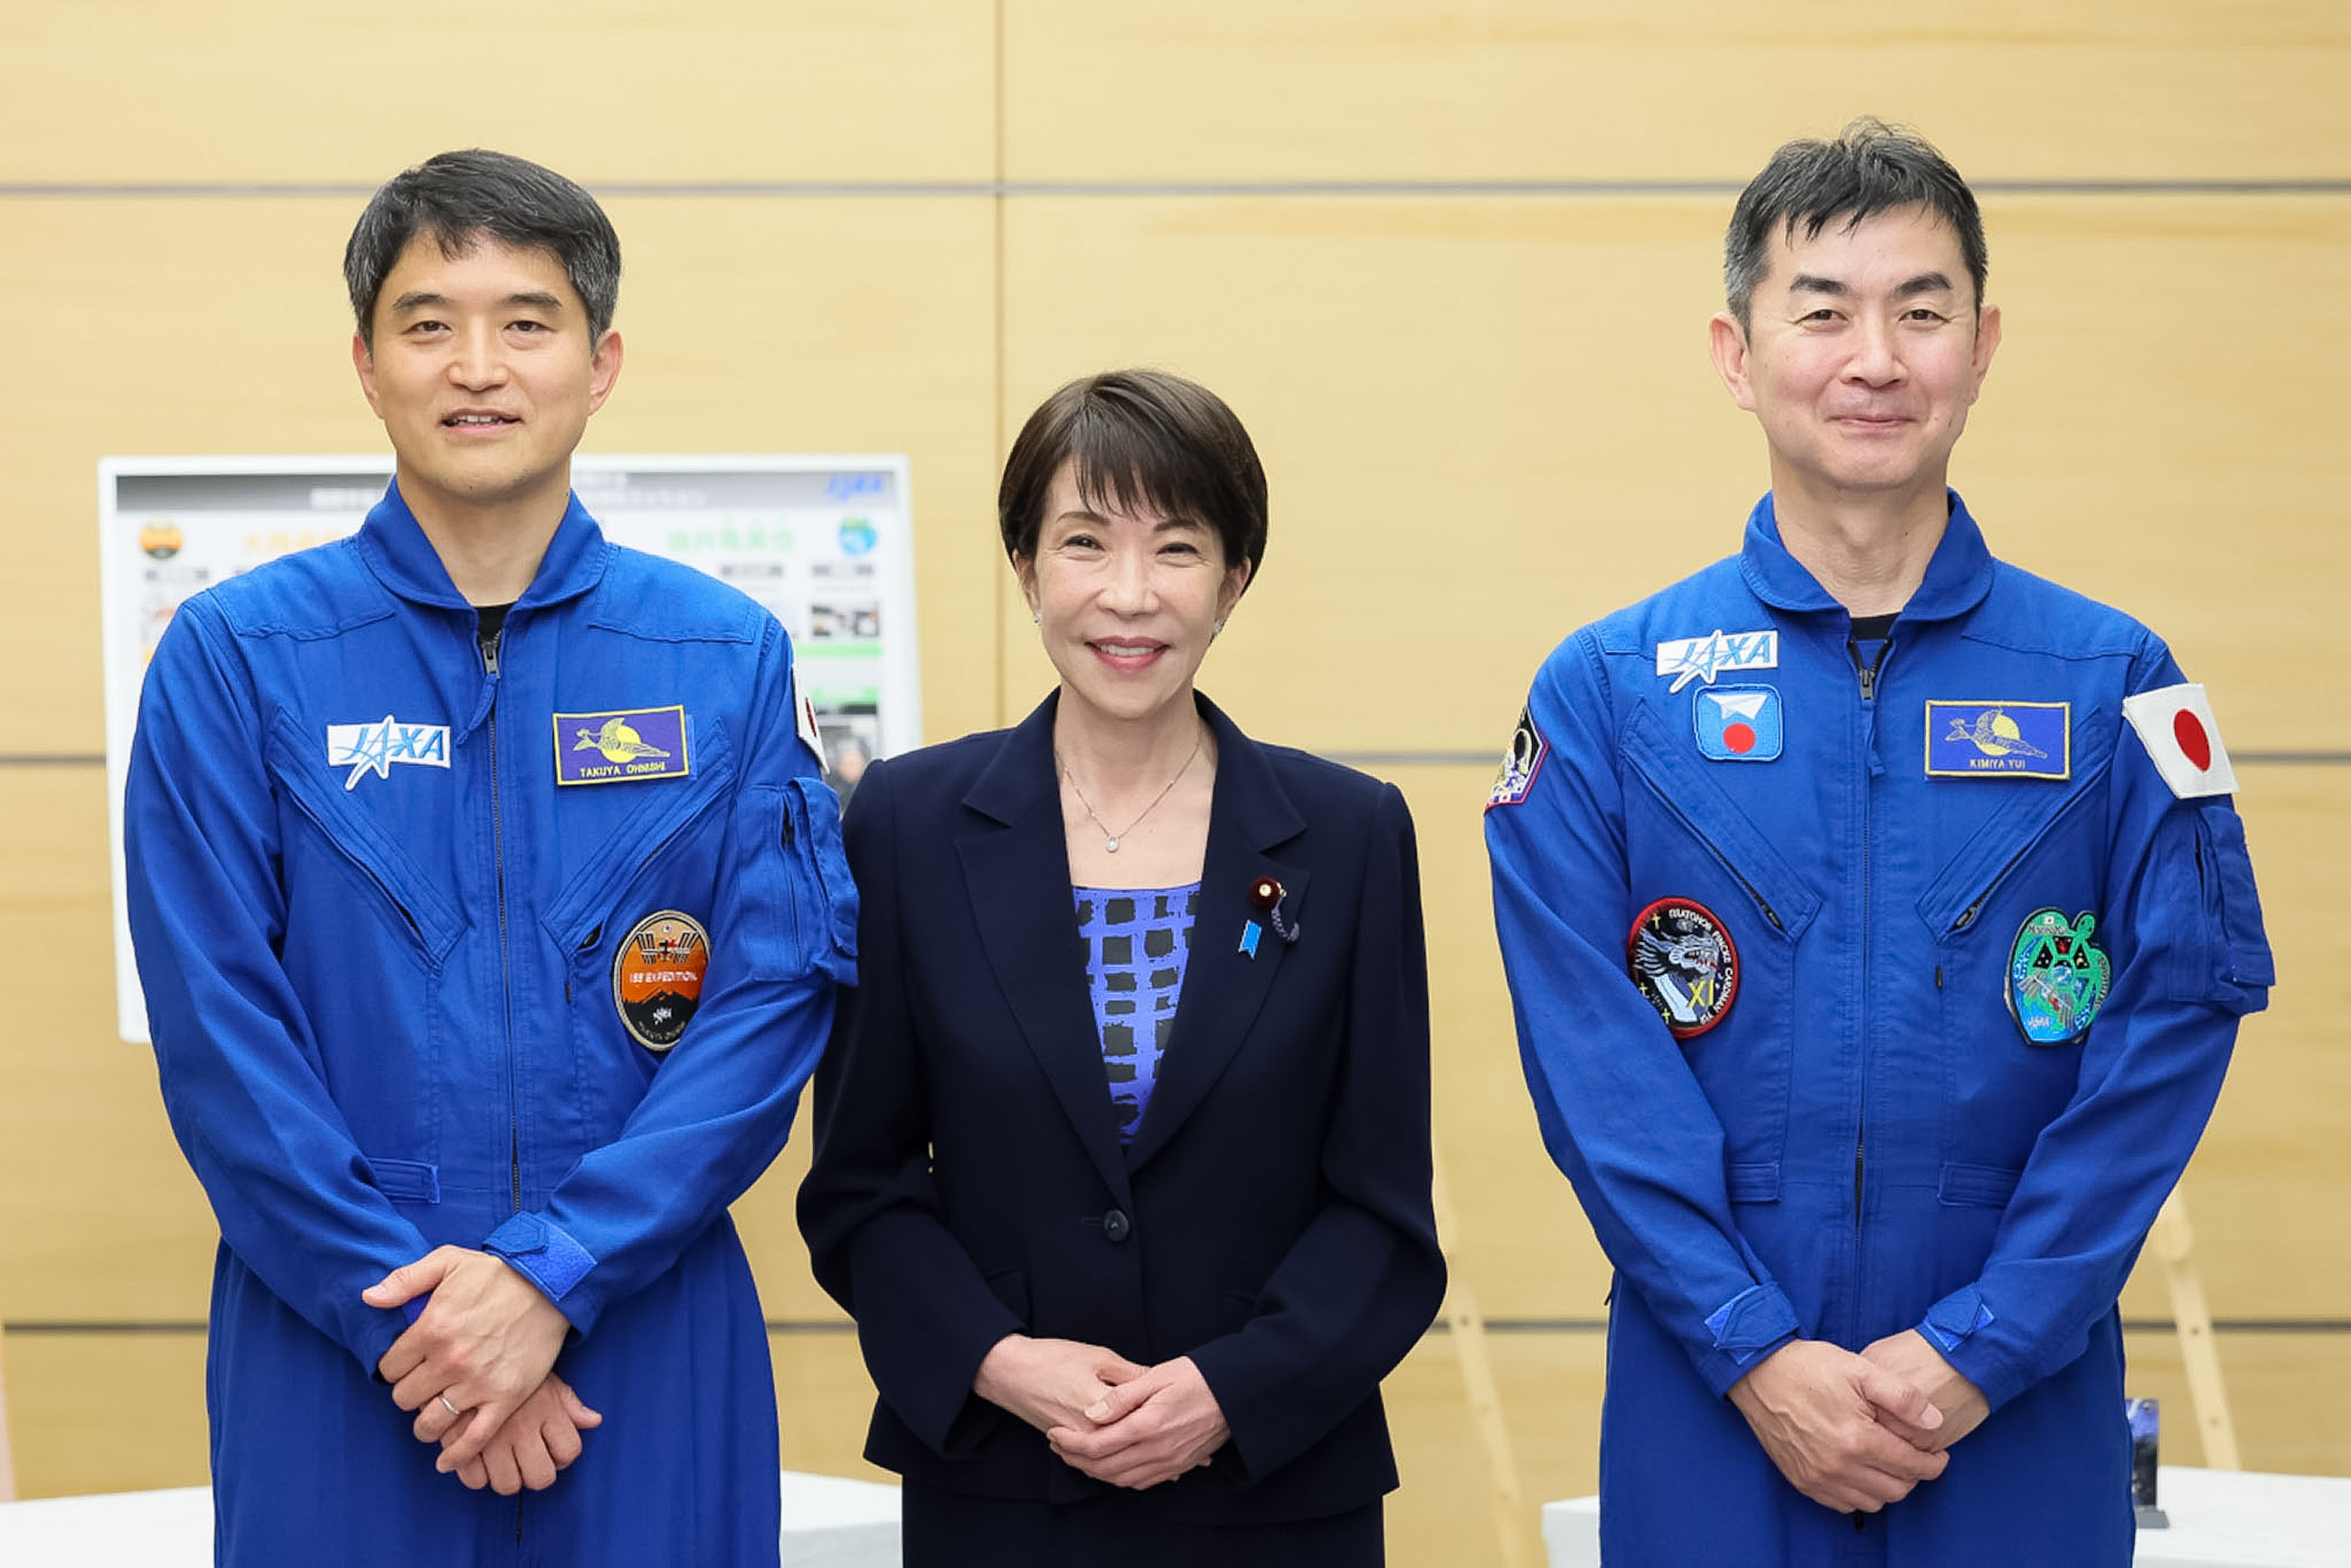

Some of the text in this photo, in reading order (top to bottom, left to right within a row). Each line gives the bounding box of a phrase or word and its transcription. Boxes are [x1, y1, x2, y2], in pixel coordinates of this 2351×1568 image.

[1663, 631, 1770, 690] JAXA
[334, 721, 444, 786] JAXA
[1969, 759, 2026, 770] KIMIYA YUI
[580, 765, 621, 779] TAKUYA
[1686, 978, 1715, 1008] XI
